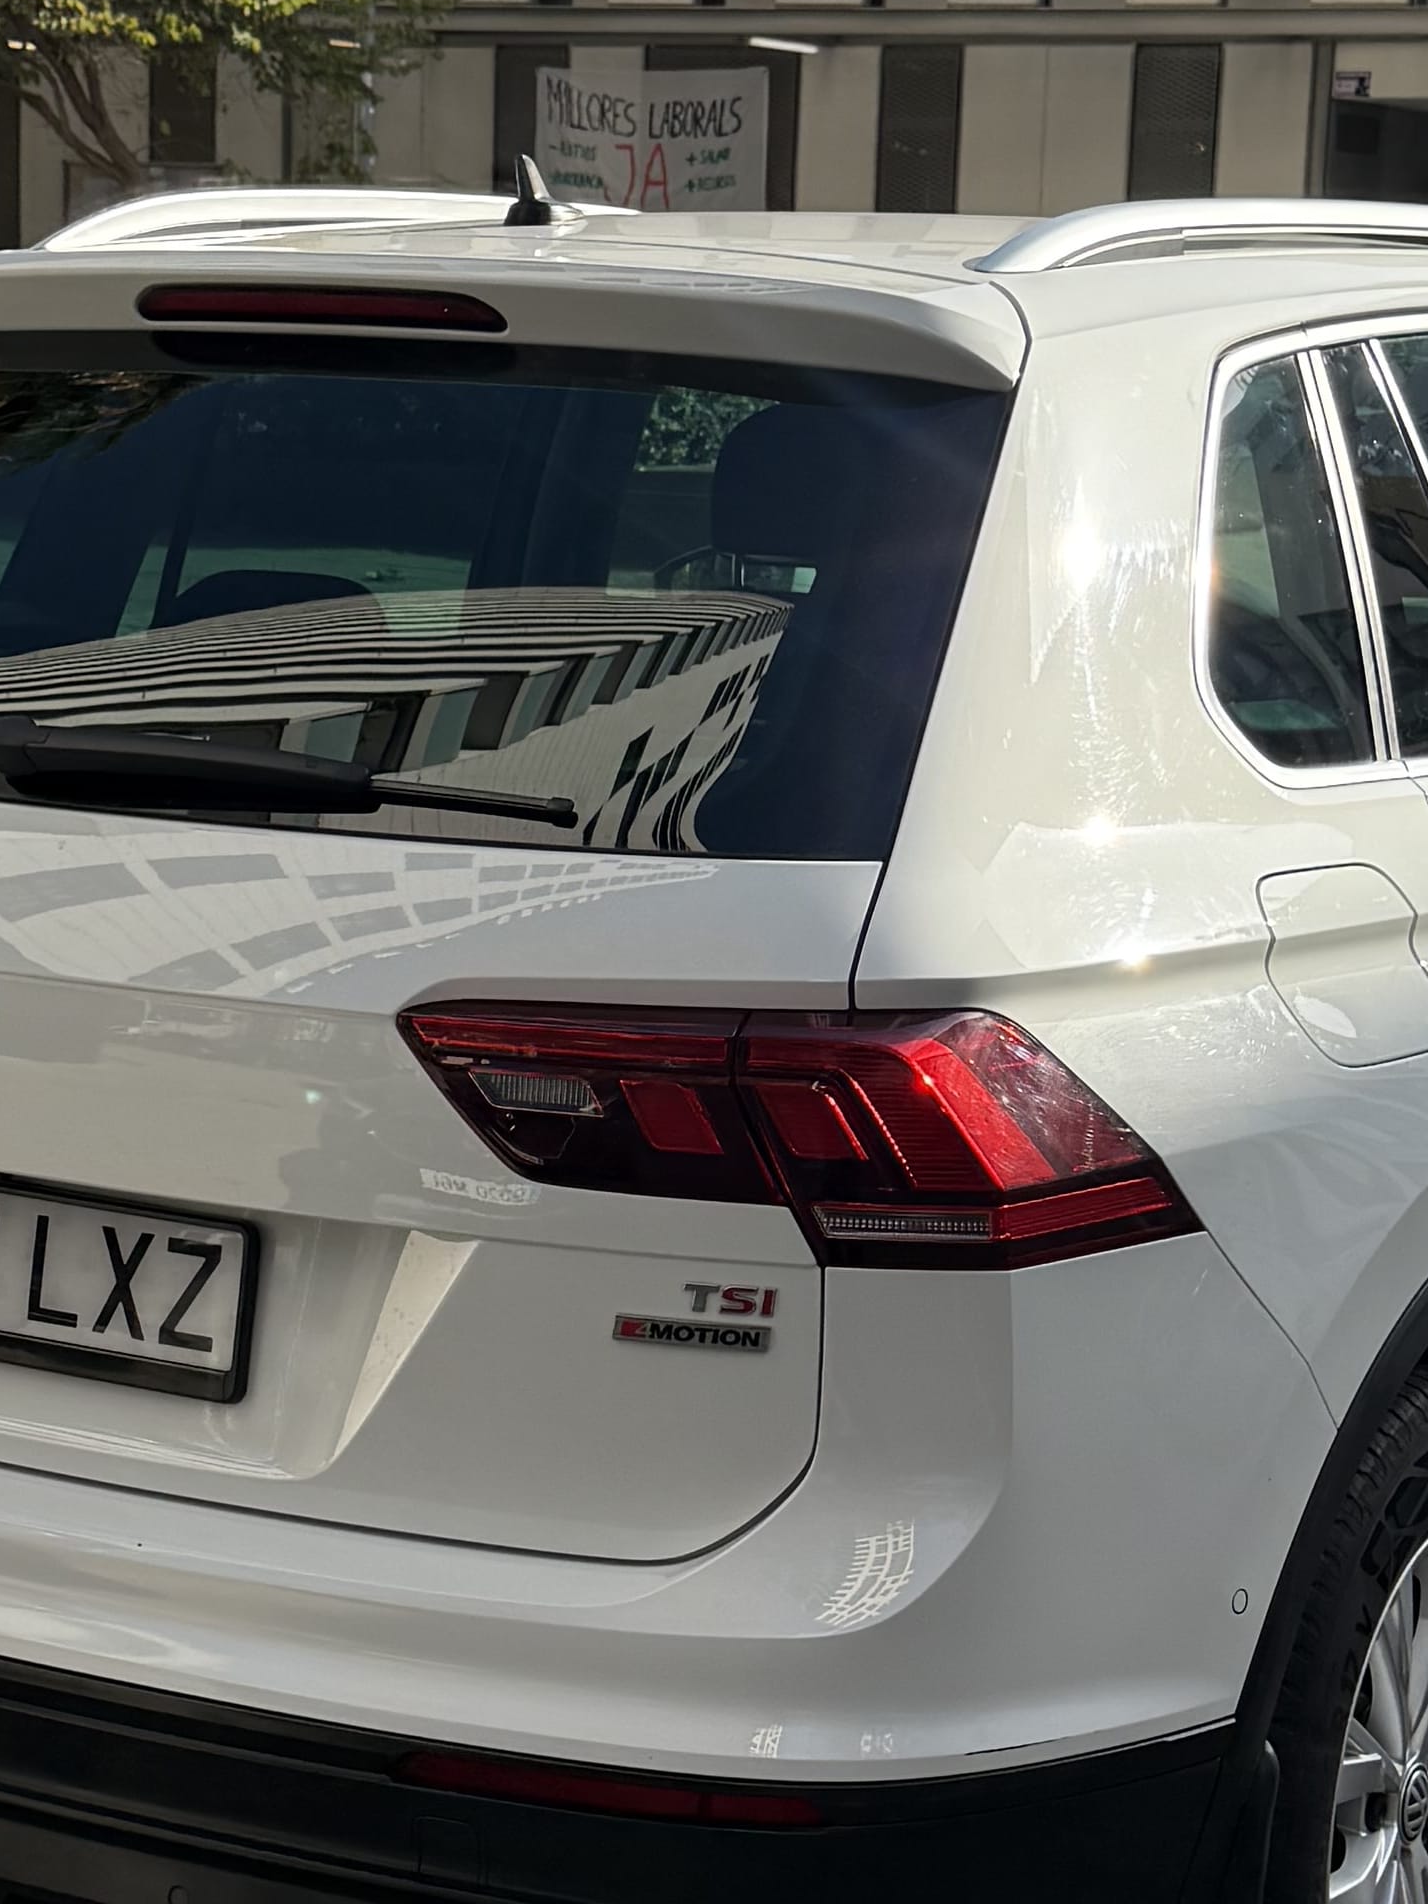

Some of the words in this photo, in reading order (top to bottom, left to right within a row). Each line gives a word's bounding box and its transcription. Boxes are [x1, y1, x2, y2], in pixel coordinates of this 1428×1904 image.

[546, 76, 637, 137] MILLORES
[649, 96, 742, 138] LABORALS
[27, 1215, 224, 1353] LXZ
[683, 1280, 778, 1318] TSI
